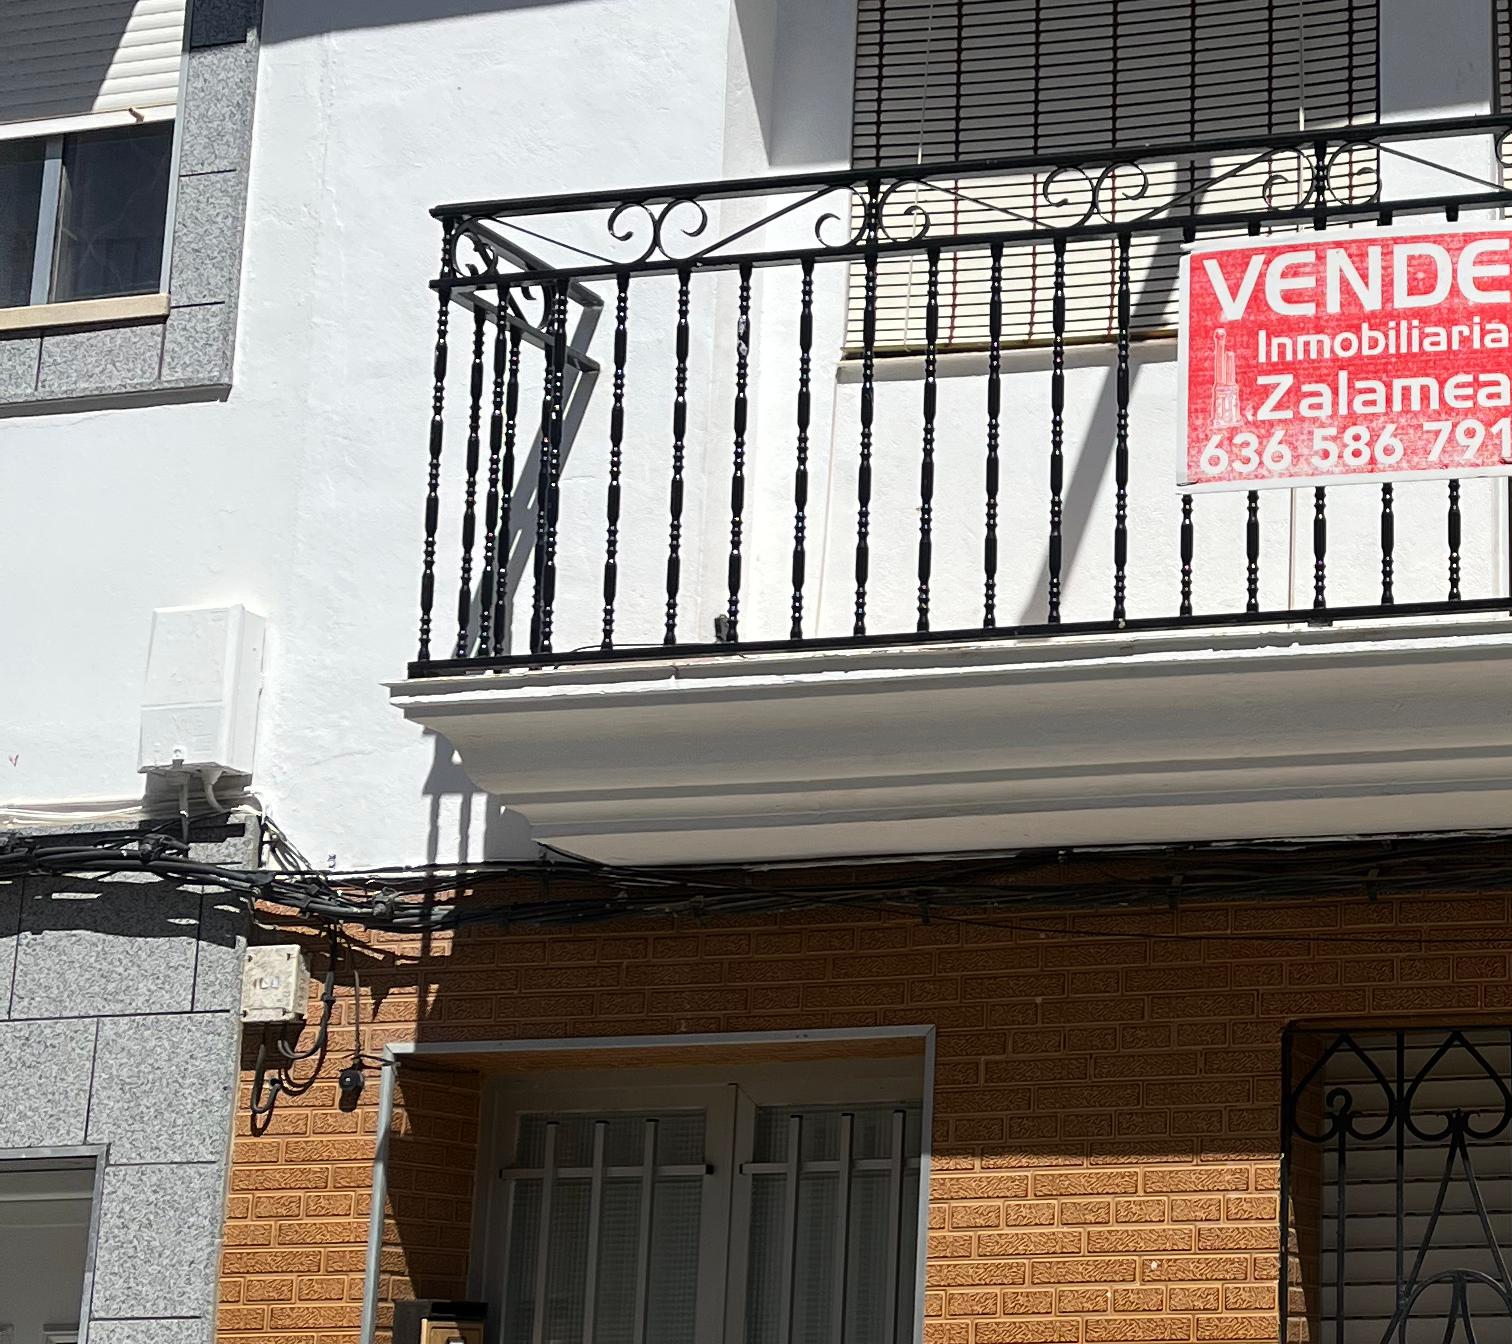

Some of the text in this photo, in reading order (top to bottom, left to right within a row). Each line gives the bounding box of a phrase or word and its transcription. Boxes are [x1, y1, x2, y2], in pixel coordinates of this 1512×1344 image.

[1202, 238, 1511, 322] VENDE
[1257, 315, 1509, 364] Inmobiliaria
[1256, 369, 1511, 421] Zalamea
[1200, 416, 1512, 476] 636 586 791
